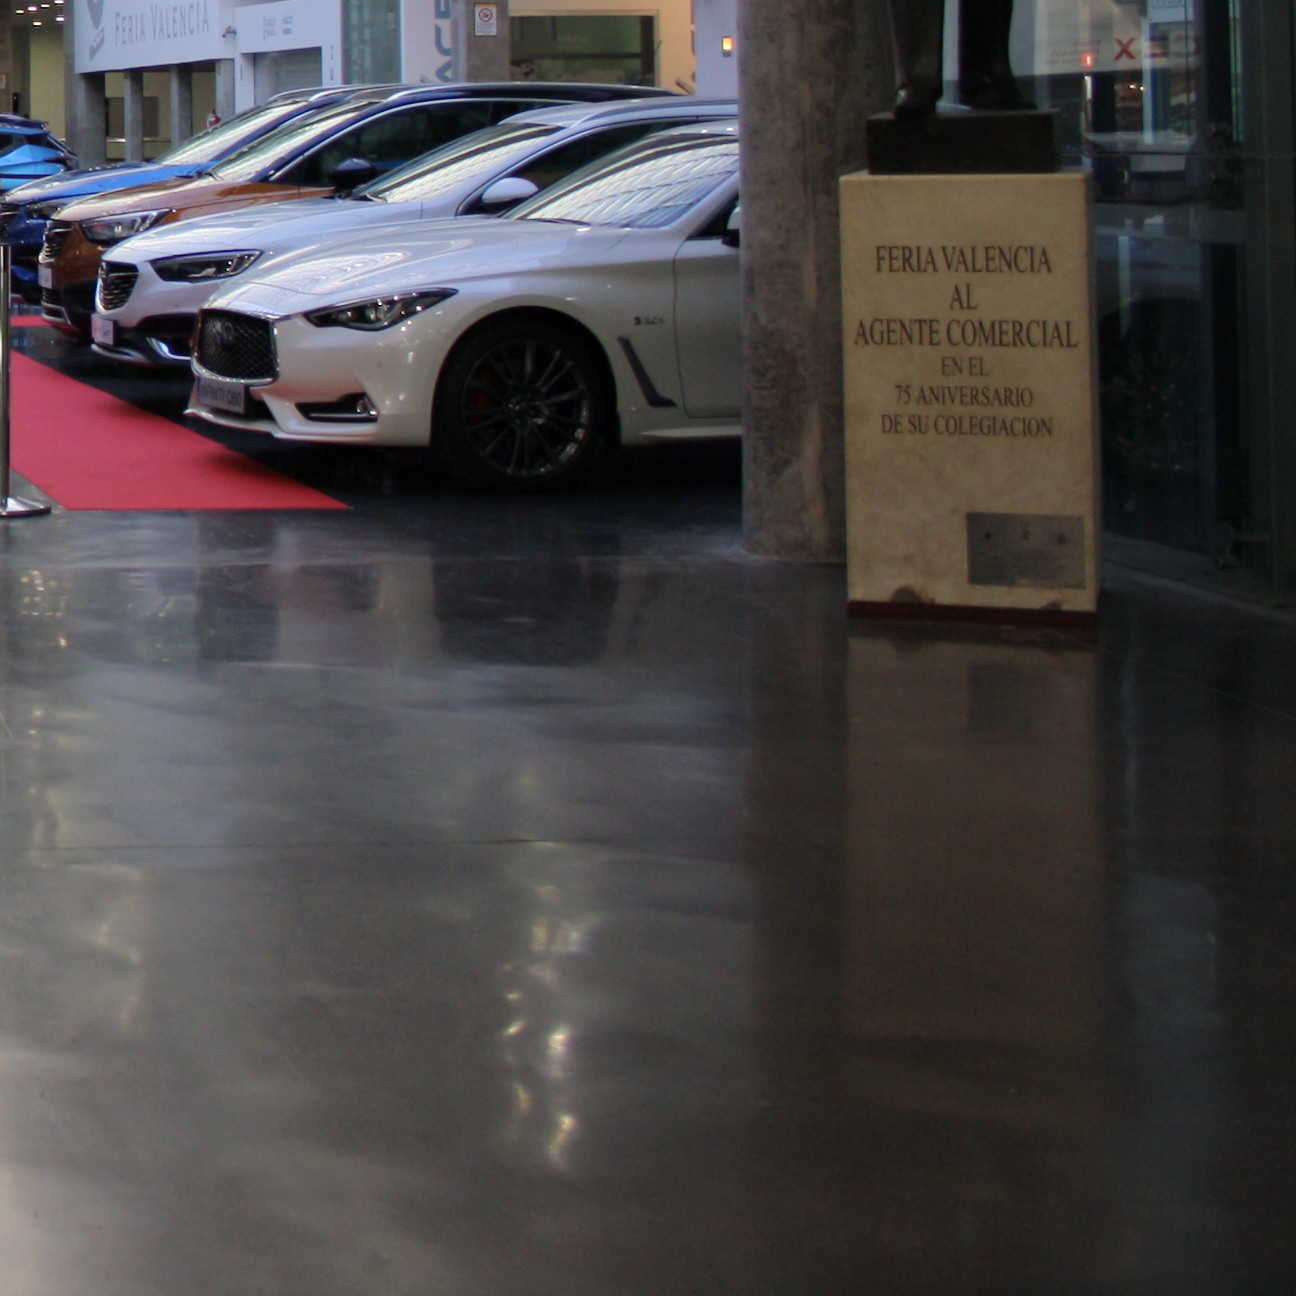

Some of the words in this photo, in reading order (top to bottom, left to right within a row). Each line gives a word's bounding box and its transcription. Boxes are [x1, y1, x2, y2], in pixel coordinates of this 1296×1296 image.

[115, 11, 145, 47] FERIA
[150, 0, 208, 40] VALENCIA
[875, 245, 938, 273] FERIA
[941, 245, 1053, 274] VALENCIA
[949, 283, 978, 310] AL
[854, 318, 941, 346] AGENTE
[946, 319, 1079, 348] COMERCIAL
[941, 357, 963, 377] EN
[969, 357, 990, 377] EL
[895, 385, 911, 405] 75
[918, 385, 1033, 407] ANIVERSARIO
[881, 414, 902, 434] DE
[908, 414, 929, 435] SU
[934, 415, 1053, 438] COLEGIACION
